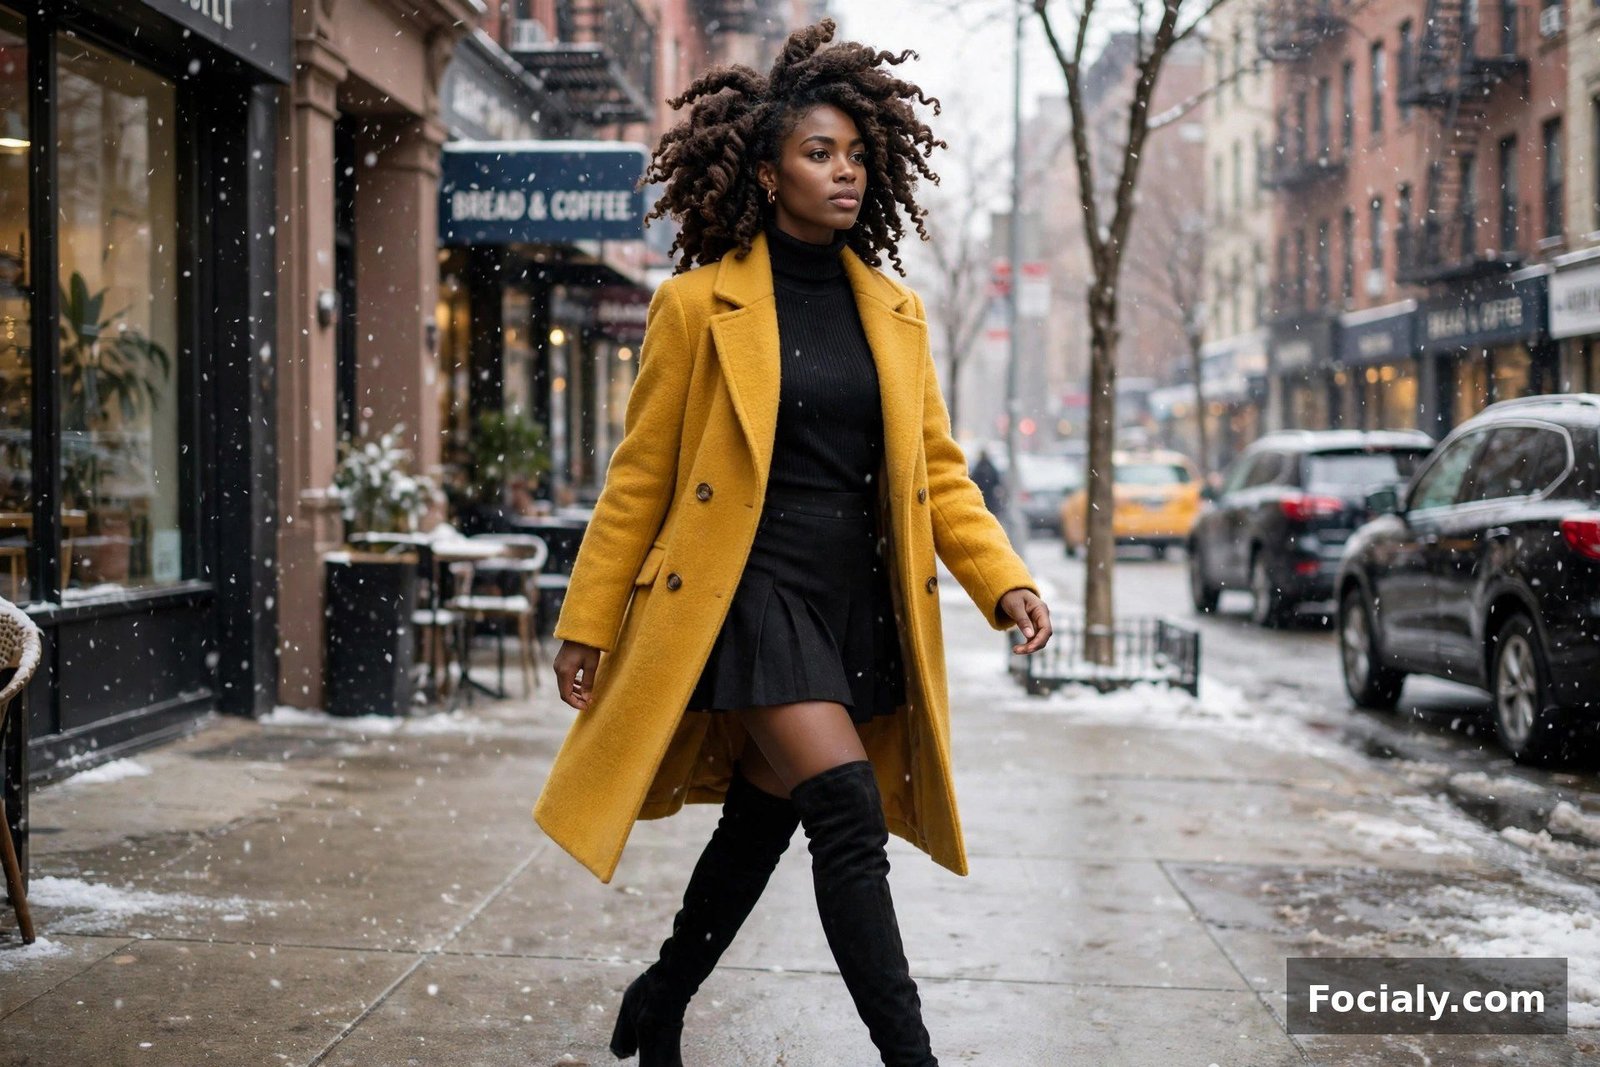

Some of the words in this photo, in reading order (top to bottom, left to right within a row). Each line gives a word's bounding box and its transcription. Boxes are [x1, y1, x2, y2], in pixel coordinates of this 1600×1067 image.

[452, 190, 526, 221] BREAD
[528, 190, 547, 221] &
[550, 190, 631, 221] COFFEE
